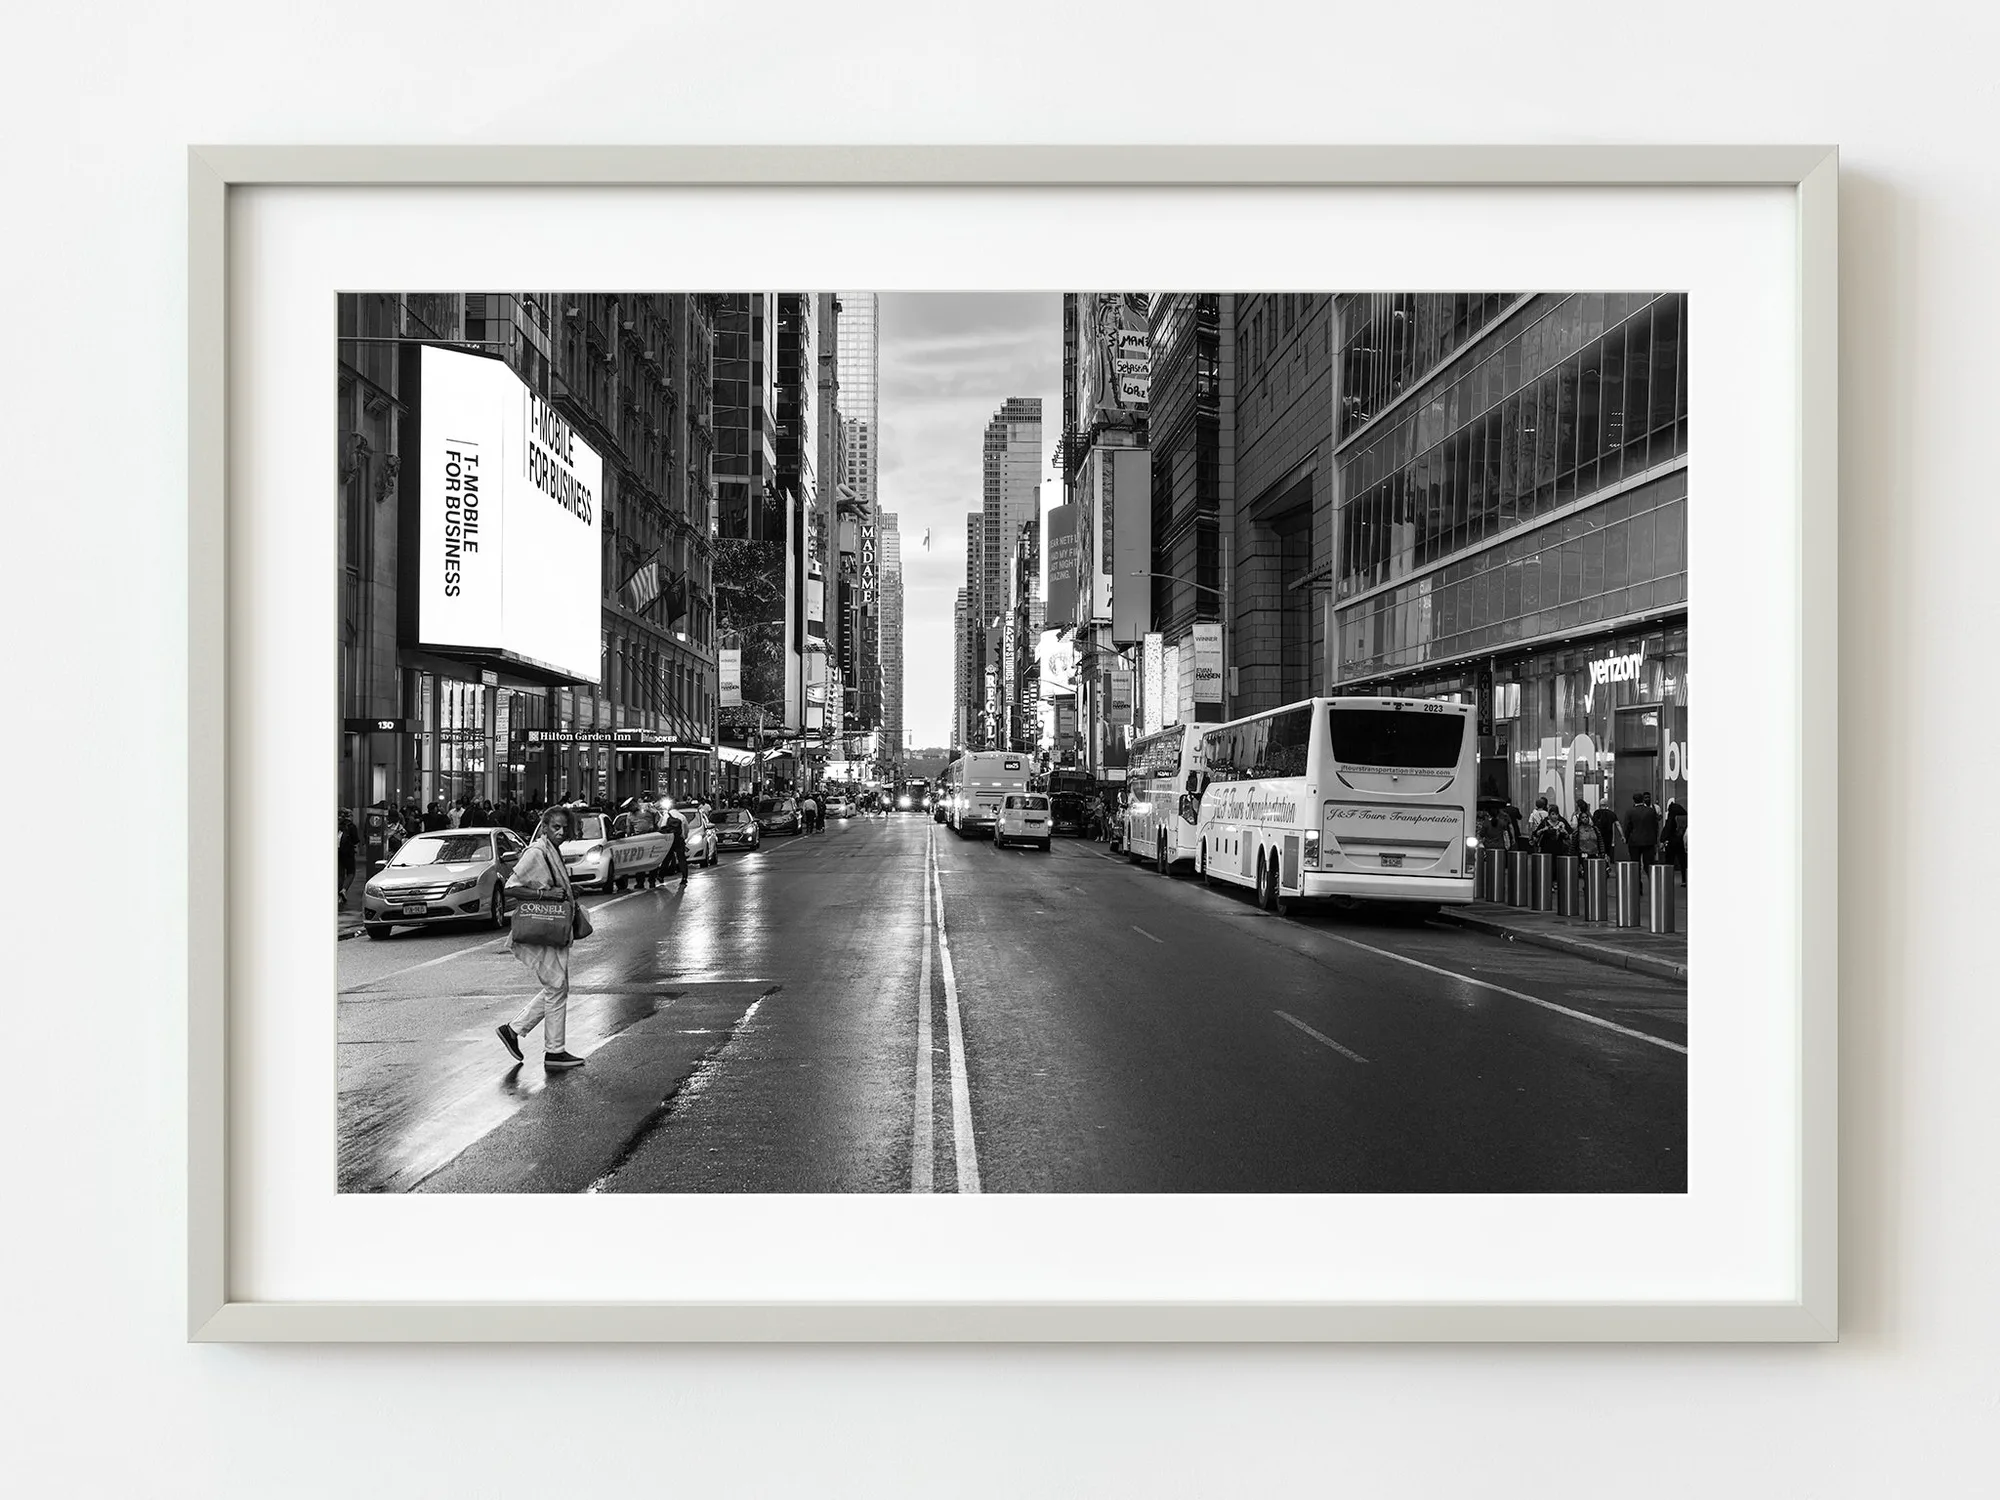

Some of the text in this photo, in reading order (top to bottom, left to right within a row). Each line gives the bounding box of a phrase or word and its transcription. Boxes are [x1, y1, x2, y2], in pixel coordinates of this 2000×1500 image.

[530, 390, 574, 468] T-MOBILE
[464, 455, 478, 553] T-MOBILE
[530, 441, 592, 526] FOR BUSINESS
[445, 451, 461, 597] FOR BUSINESS
[861, 526, 875, 602] MADAME
[1586, 648, 1643, 706] verizon
[378, 721, 394, 729] 130
[985, 675, 996, 738] REGAL
[1424, 704, 1443, 712] 2023
[540, 732, 573, 741] Hilton
[575, 733, 611, 741] Garden
[614, 733, 631, 741] Inn
[1326, 809, 1458, 824] J&F Tours Transportation
[614, 847, 644, 864] NYPD
[520, 903, 566, 914] CORNELL
